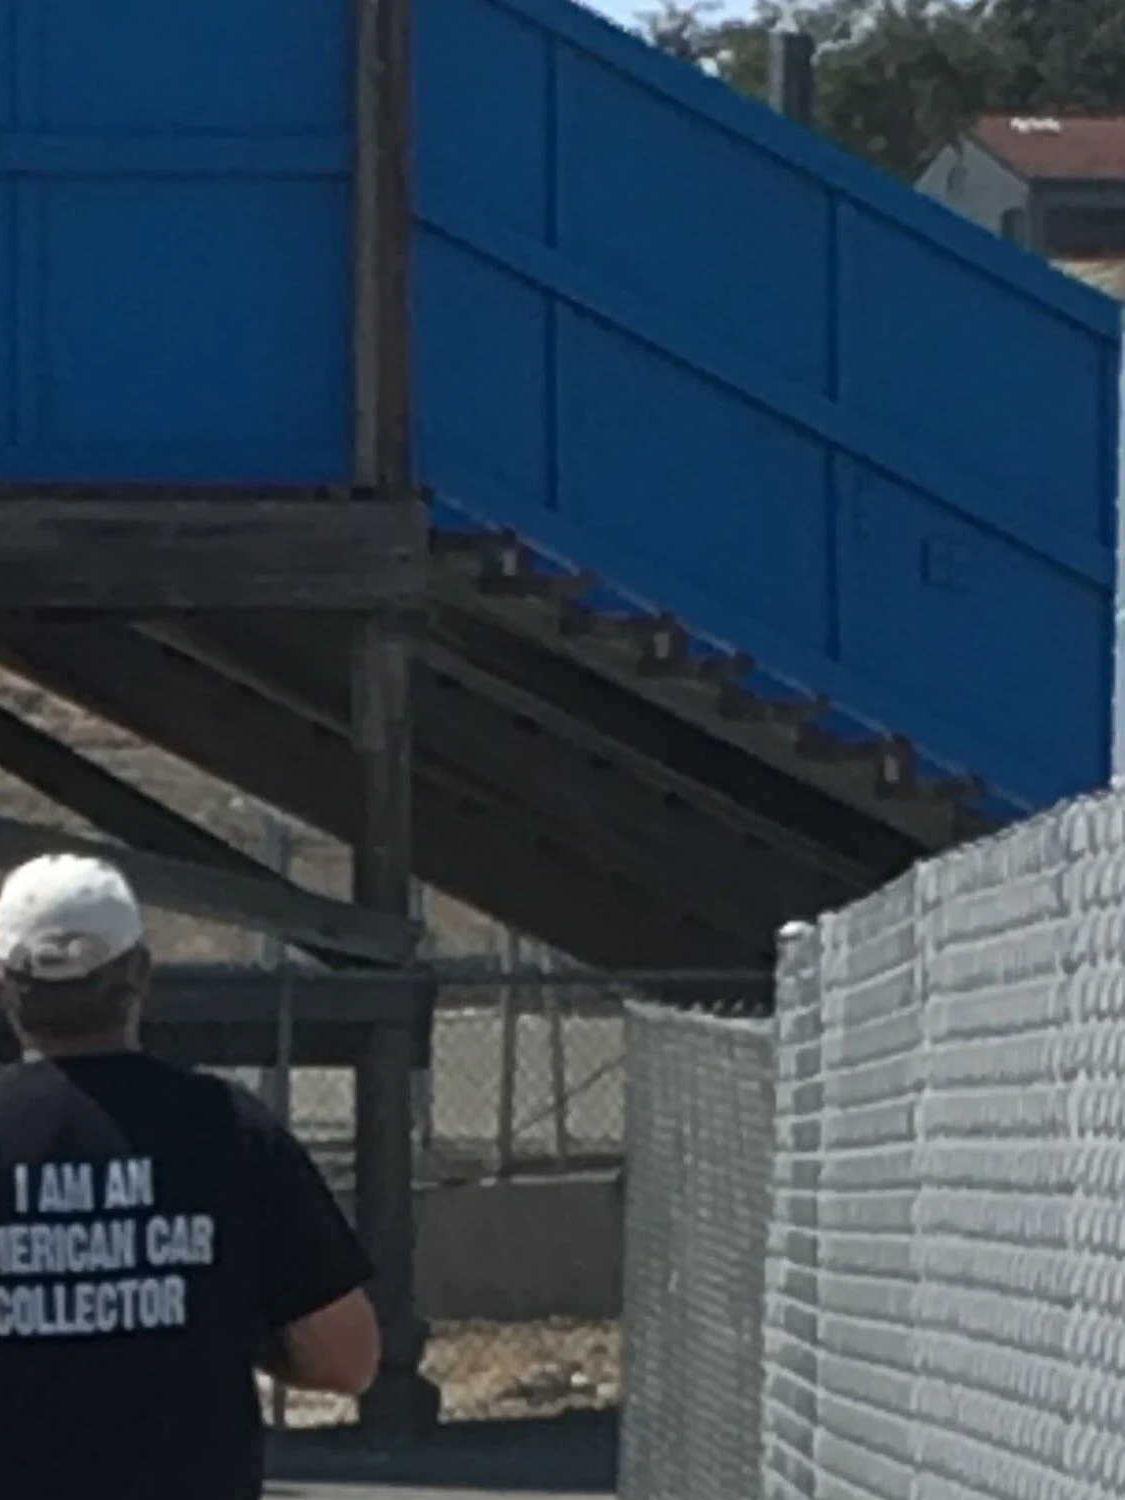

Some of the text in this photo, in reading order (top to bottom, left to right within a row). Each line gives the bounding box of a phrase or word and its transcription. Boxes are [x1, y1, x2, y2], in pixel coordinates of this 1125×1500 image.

[14, 1158, 154, 1213] I AM AN
[146, 1215, 214, 1265] CAR
